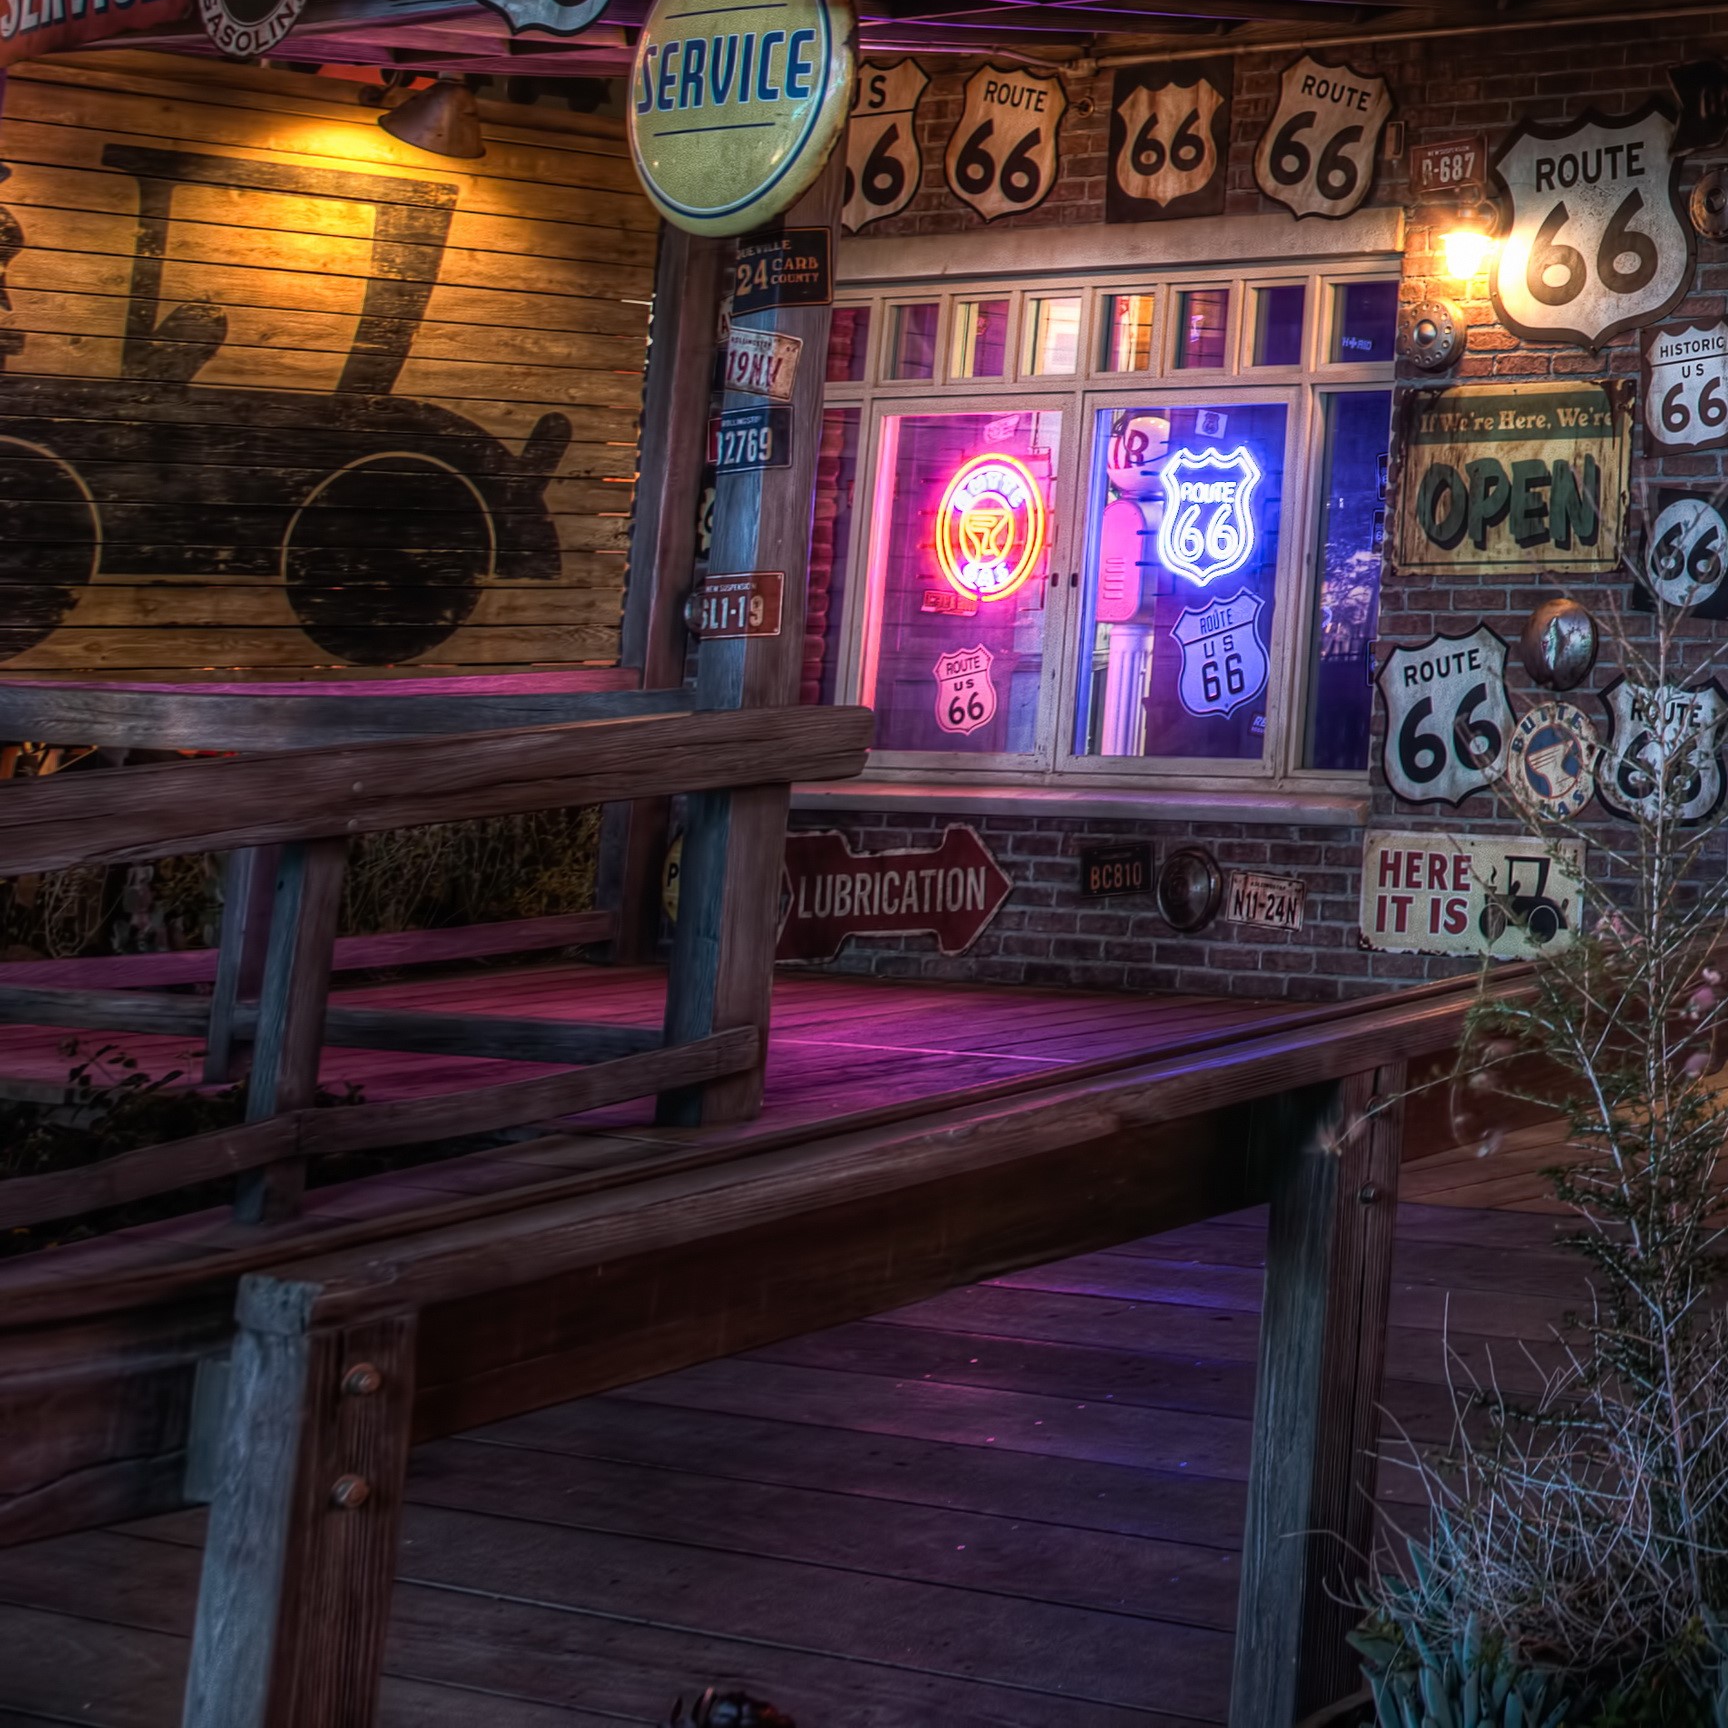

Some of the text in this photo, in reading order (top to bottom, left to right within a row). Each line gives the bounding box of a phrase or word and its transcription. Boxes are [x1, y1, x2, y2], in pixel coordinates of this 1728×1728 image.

[637, 27, 817, 116] SERVICE
[982, 80, 1048, 114] ROUTE
[1301, 74, 1372, 113] ROUTE
[1131, 106, 1208, 176] 66
[1269, 110, 1364, 201] 66
[955, 118, 1050, 207] 66
[1534, 141, 1646, 194] ROUTE
[771, 256, 819, 271] CARB
[1525, 187, 1659, 307] 66
[770, 272, 820, 285] COUNTY
[1658, 334, 1726, 360] HISTORIC
[1681, 362, 1706, 379] US
[1420, 405, 1613, 433] If We're Here, We're
[1661, 375, 1728, 434] 66
[1180, 480, 1238, 506] ROUTE
[1414, 452, 1600, 552] OPEN
[1175, 502, 1237, 564] 66
[1650, 521, 1723, 585] 66
[1199, 607, 1235, 635] ROUTE
[944, 655, 981, 677] ROUTE
[1202, 634, 1235, 660] US
[1403, 647, 1483, 688] ROUTE
[952, 677, 975, 692] US
[1202, 652, 1245, 703] 66
[947, 692, 985, 726] 66
[1511, 701, 1585, 752] BUTTE
[1629, 701, 1704, 729] ROUTE
[1399, 682, 1501, 784] 66
[1617, 729, 1704, 803] 66
[1090, 860, 1143, 891] BC810
[1378, 849, 1473, 892] HERE
[797, 865, 988, 922] LUBRICATION
[1233, 887, 1299, 927] N11-24N
[1375, 894, 1470, 936] IT IS
